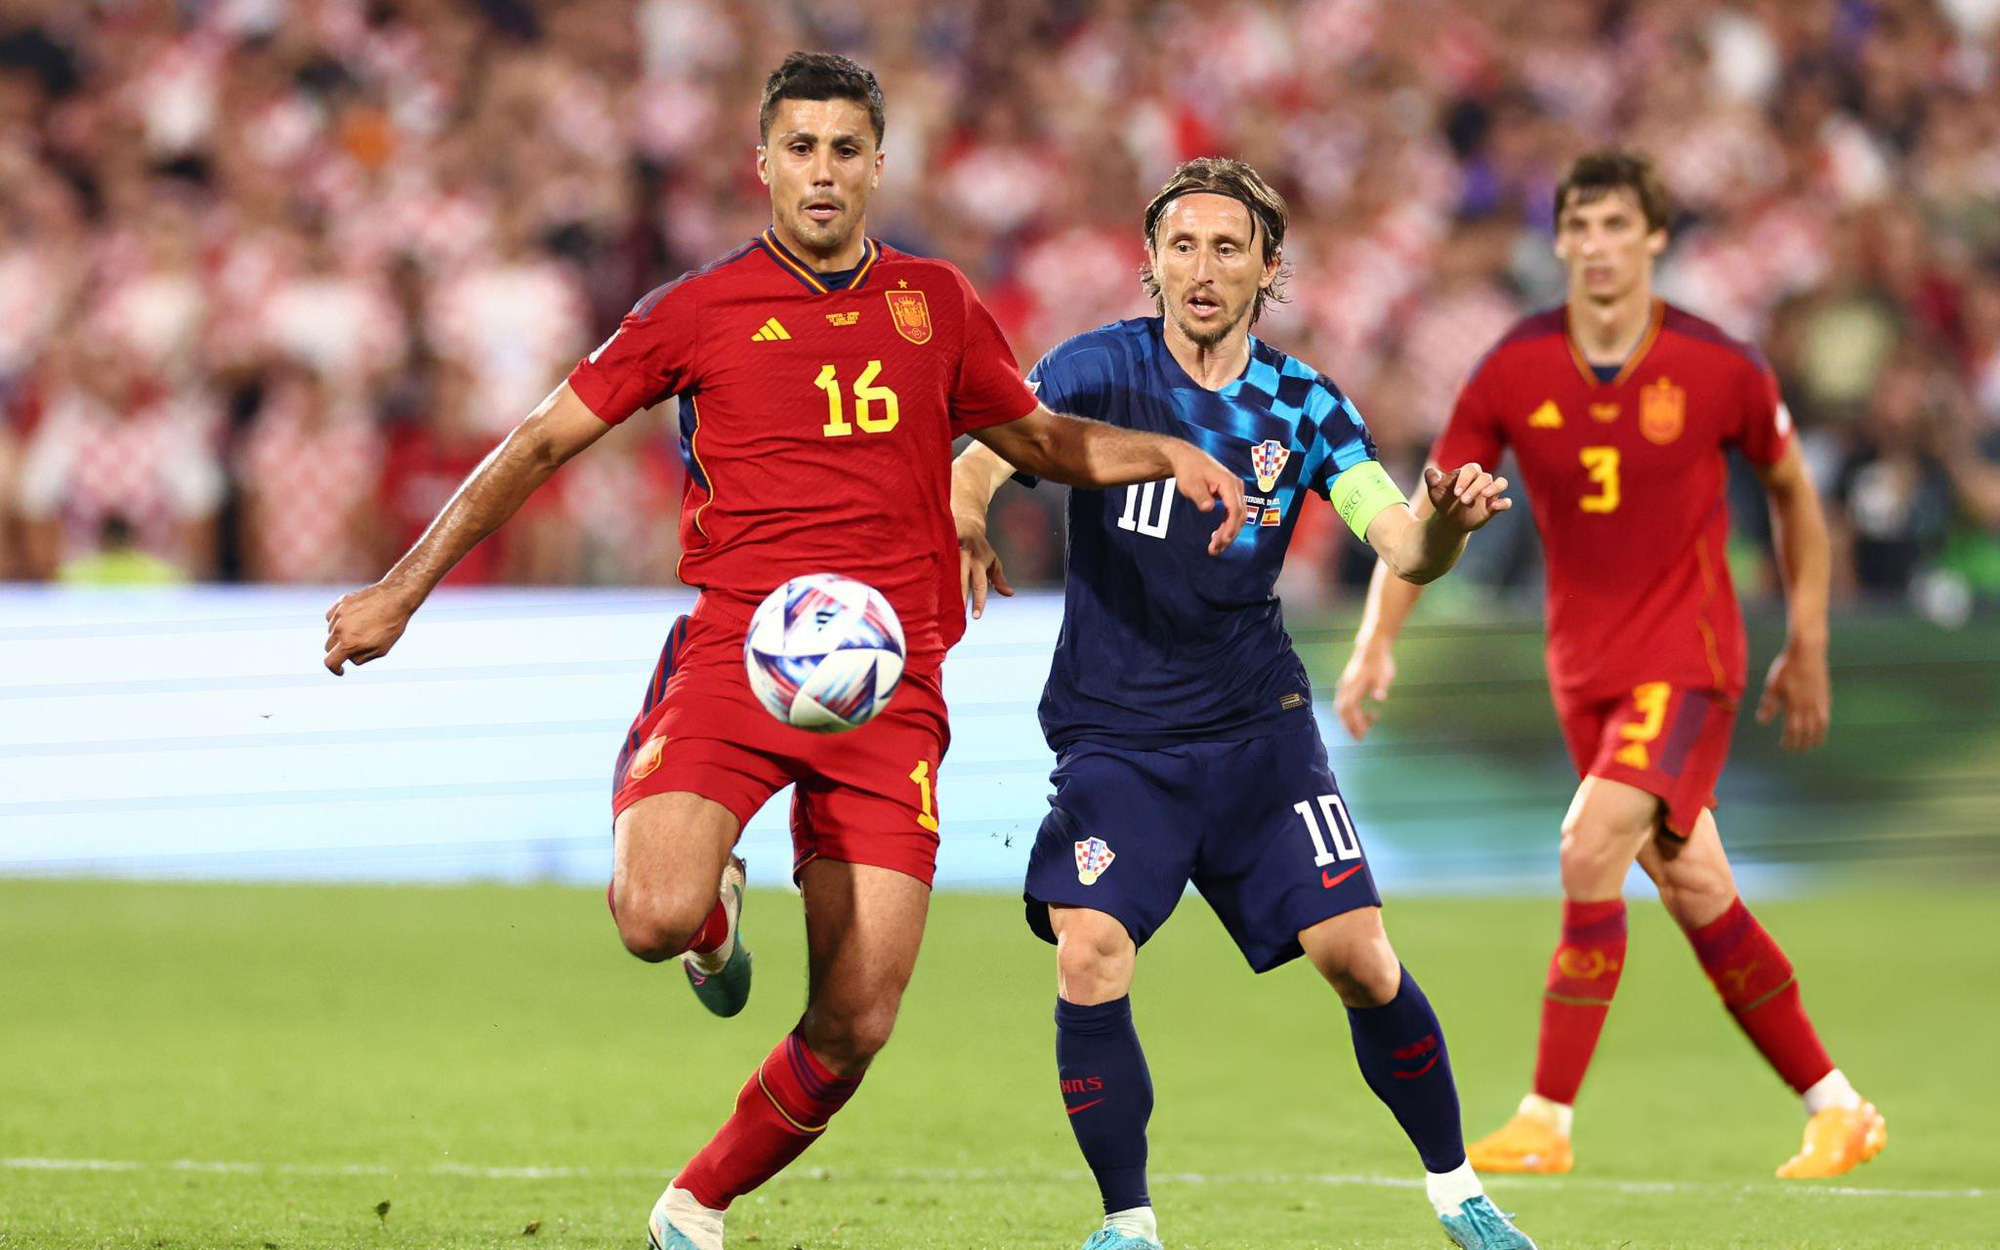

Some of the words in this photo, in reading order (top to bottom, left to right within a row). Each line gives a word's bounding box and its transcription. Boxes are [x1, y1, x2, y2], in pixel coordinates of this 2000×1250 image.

[813, 360, 899, 437] 16
[1117, 477, 1177, 539] 10
[1579, 446, 1621, 514] 3
[1619, 681, 1673, 742] 3
[1293, 794, 1361, 867] 10
